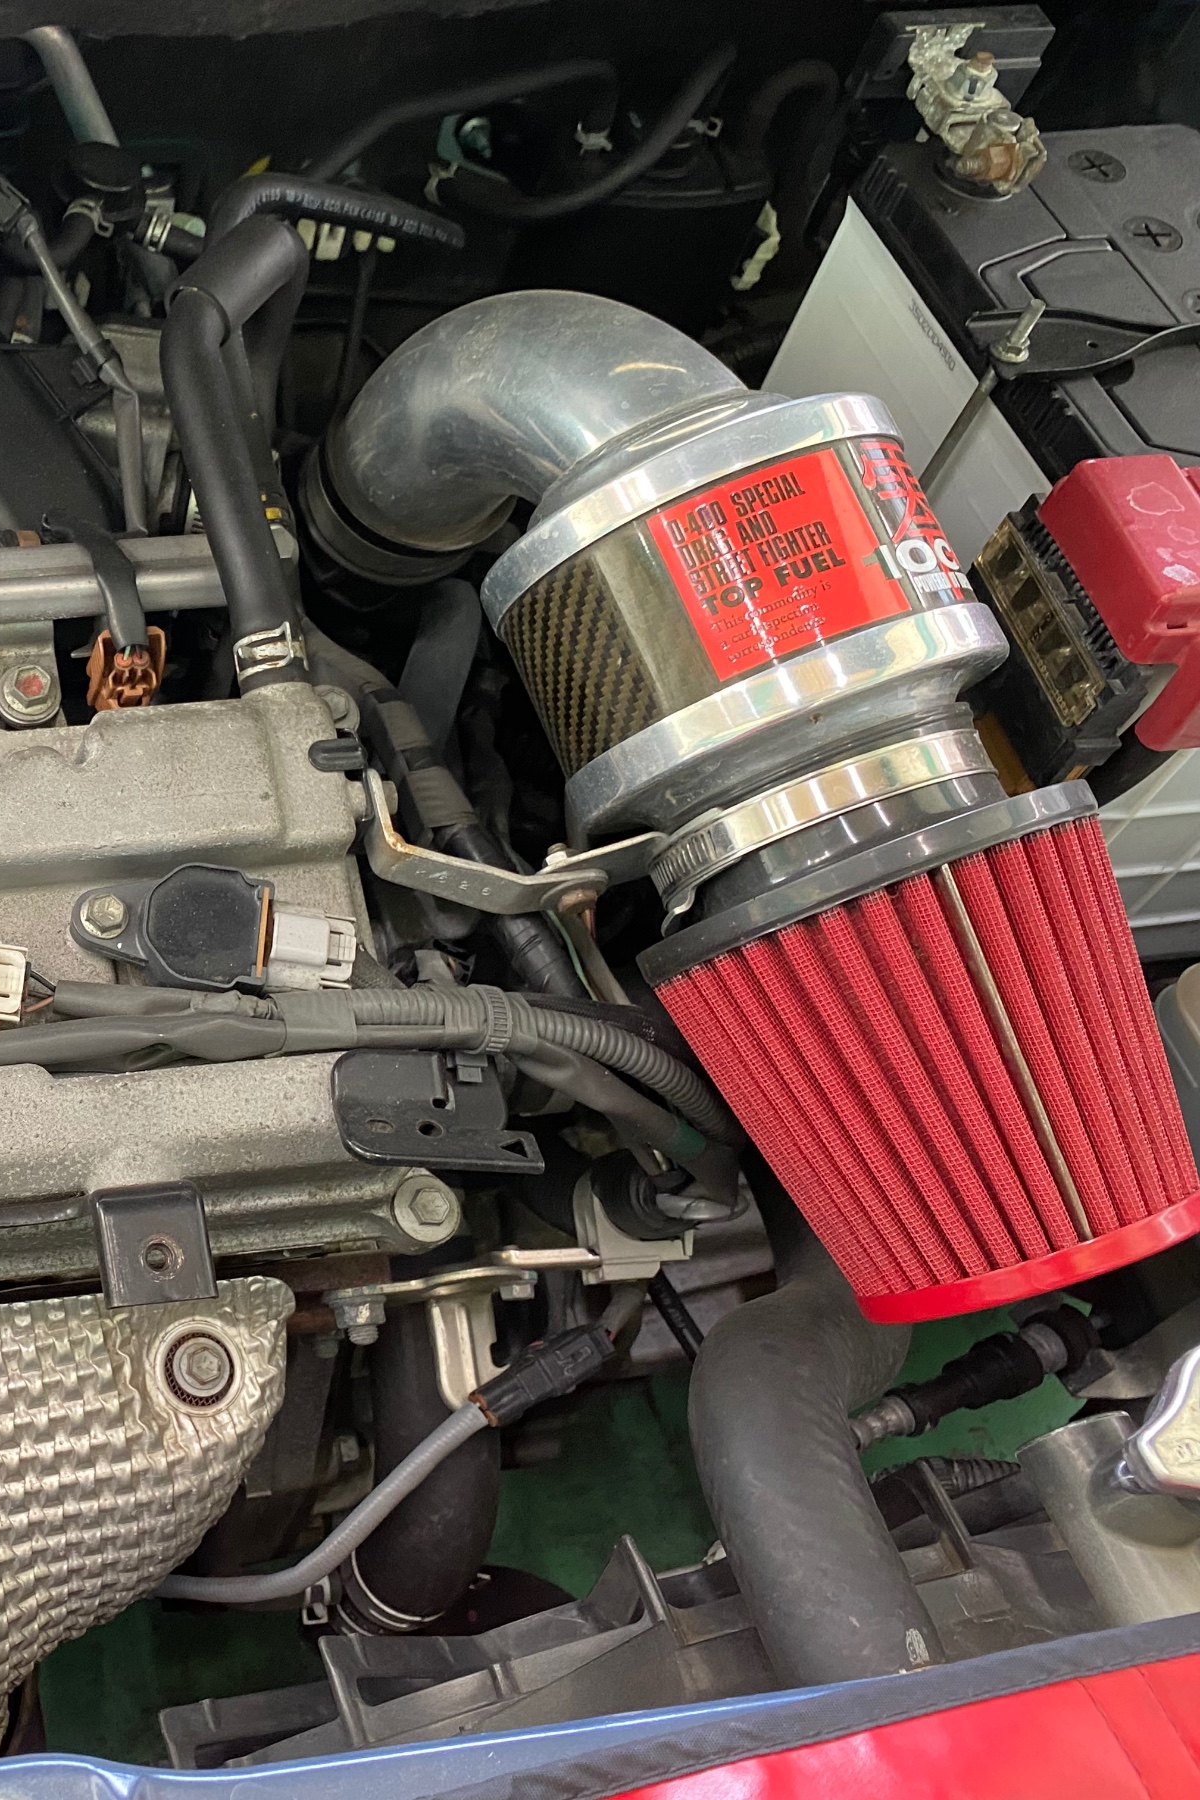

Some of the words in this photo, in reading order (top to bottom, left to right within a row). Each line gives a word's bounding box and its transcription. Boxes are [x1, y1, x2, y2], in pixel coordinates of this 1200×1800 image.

[729, 472, 806, 518] SPECIAL
[676, 527, 734, 571] DRAG
[736, 510, 778, 547] AND
[687, 548, 756, 596] STREET
[757, 521, 833, 567] FIGHTER
[702, 576, 764, 616] TOP
[773, 547, 846, 588] FUEL
[712, 612, 745, 634] This
[745, 584, 818, 621] commodity
[819, 580, 832, 592] is
[731, 629, 751, 645] car
